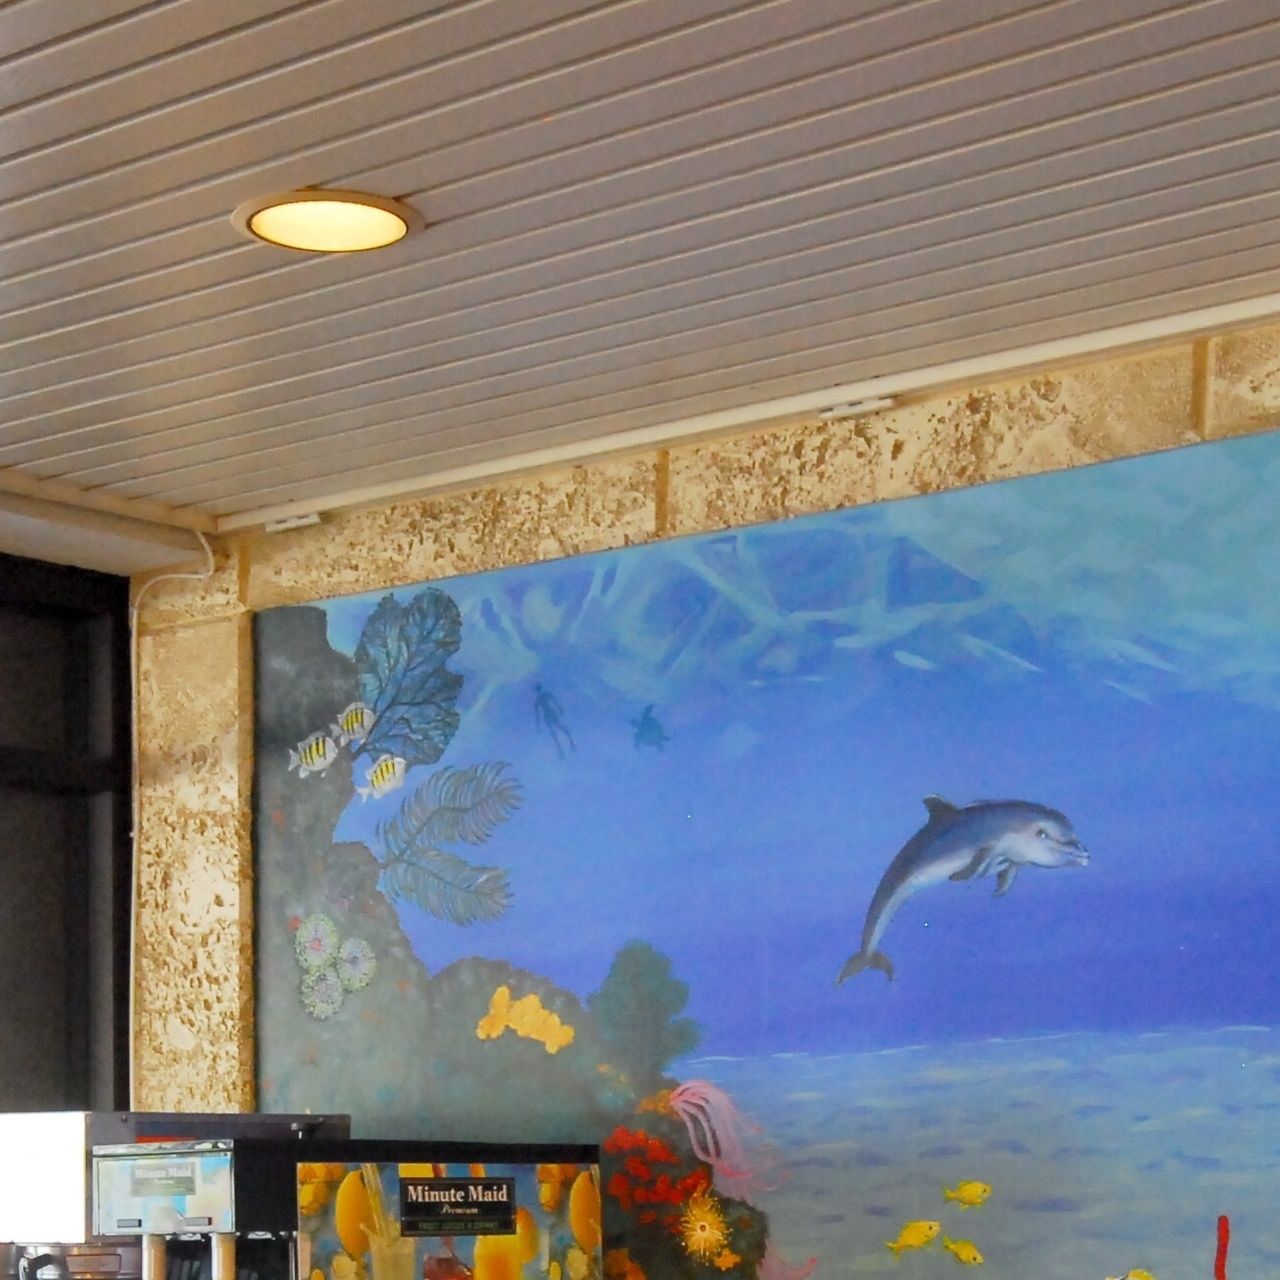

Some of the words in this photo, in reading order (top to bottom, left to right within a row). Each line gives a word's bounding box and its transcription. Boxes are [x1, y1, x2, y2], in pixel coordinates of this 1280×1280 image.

[407, 1186, 465, 1202] Minute
[468, 1184, 508, 1202] Maid
[441, 1205, 479, 1214] Premium
